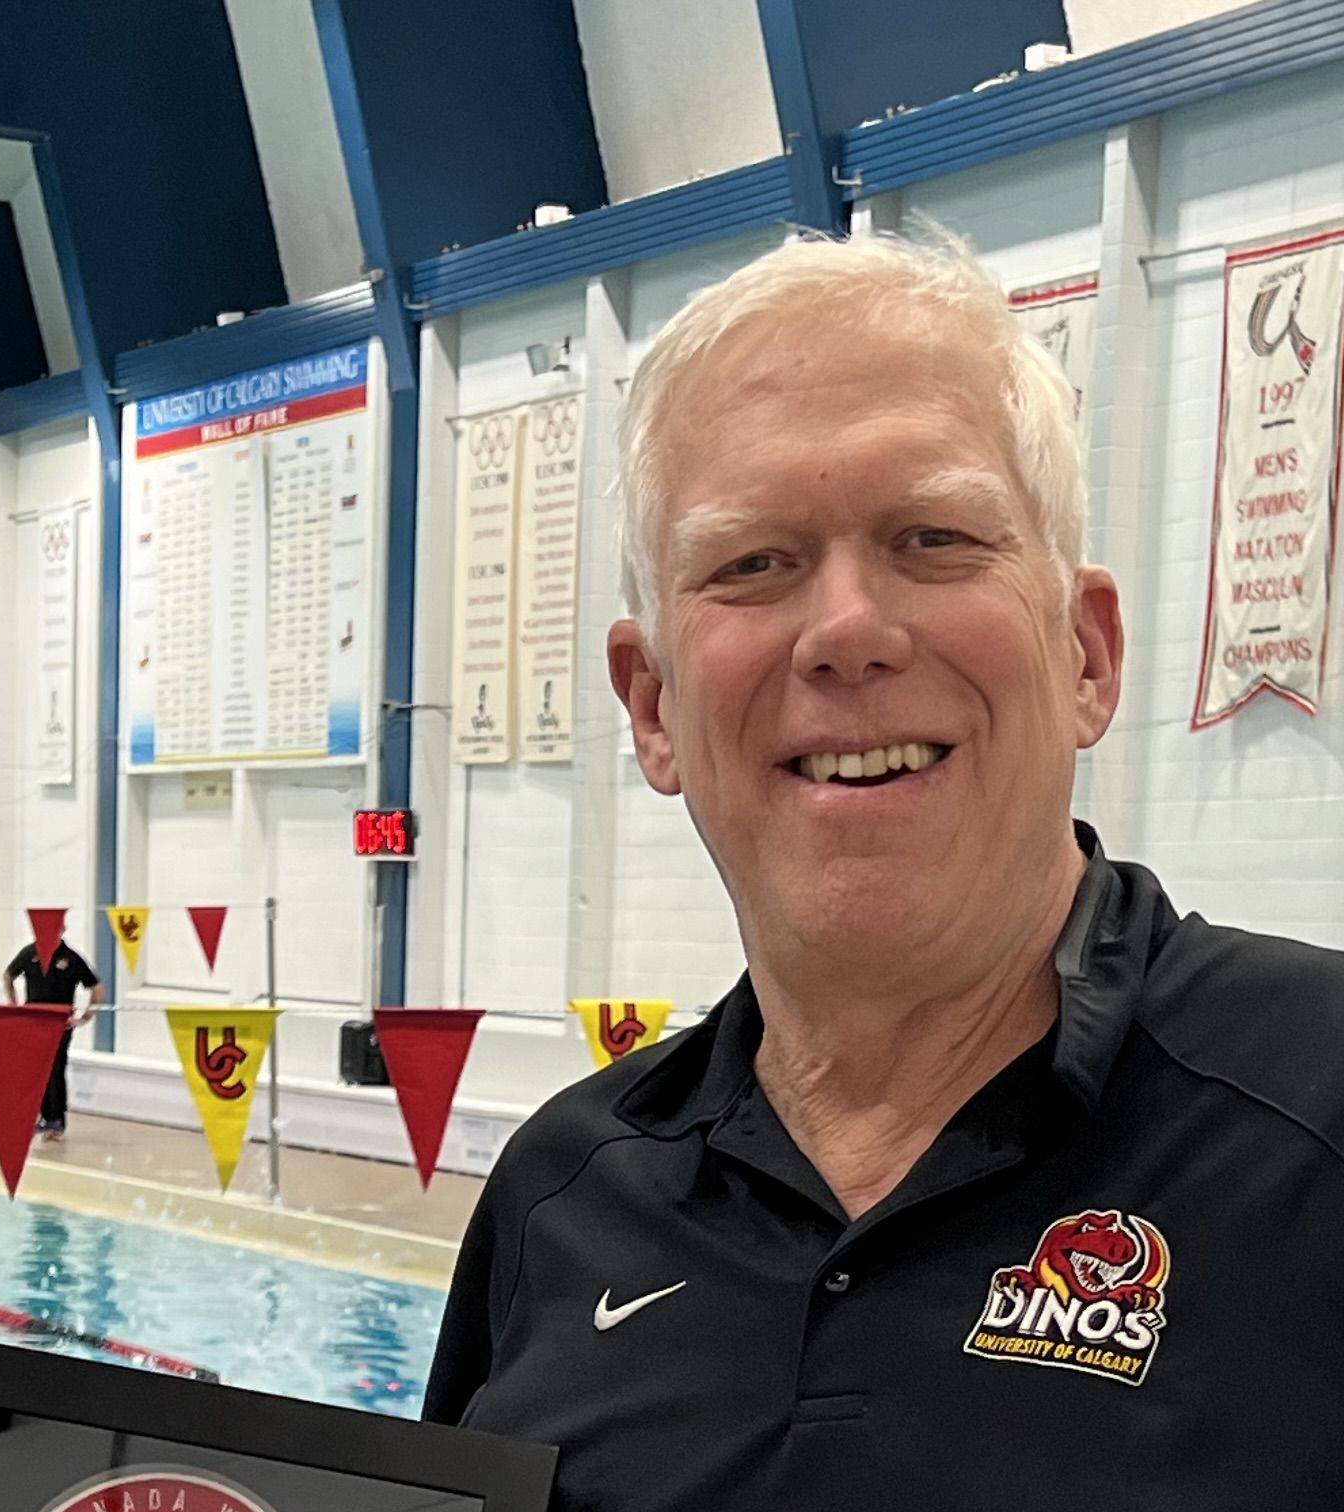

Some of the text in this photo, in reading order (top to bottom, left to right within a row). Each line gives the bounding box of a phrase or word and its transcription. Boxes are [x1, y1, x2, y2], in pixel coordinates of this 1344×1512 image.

[982, 1286, 1157, 1351] DINOS
[975, 1333, 1142, 1375] UNIVERSITY OF CALGARY
